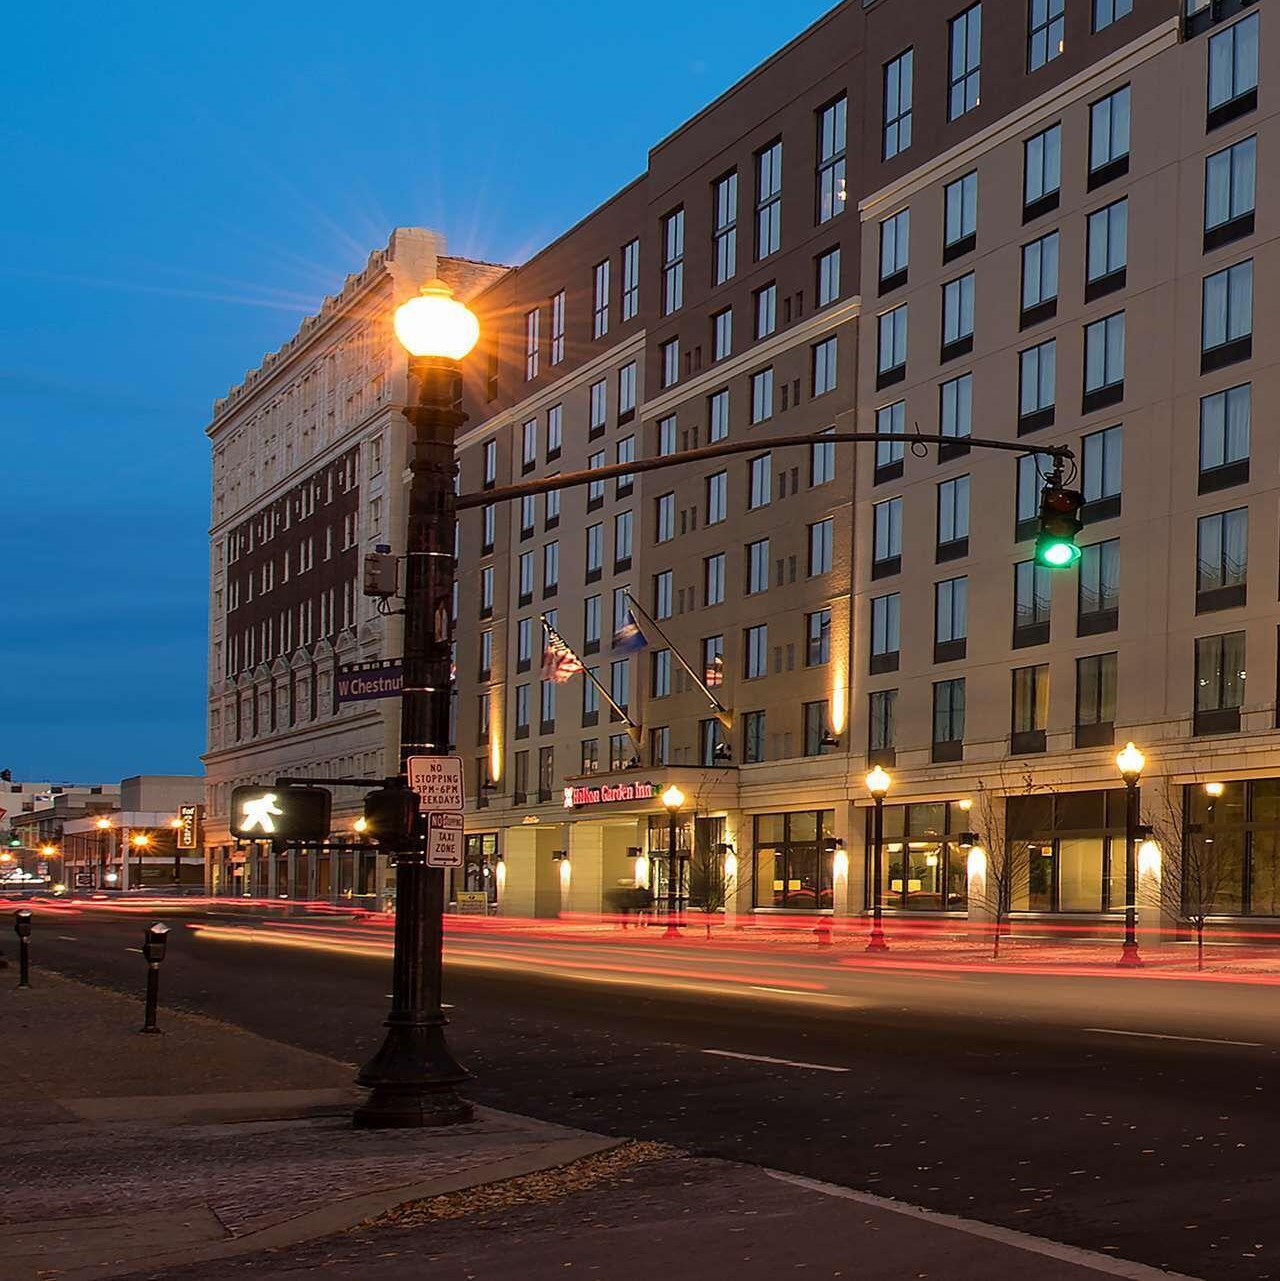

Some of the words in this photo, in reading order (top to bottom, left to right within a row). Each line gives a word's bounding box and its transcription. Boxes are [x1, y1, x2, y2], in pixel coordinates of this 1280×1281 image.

[338, 679, 350, 697] W
[430, 764, 442, 772] NO
[415, 774, 459, 784] STOPPING
[601, 783, 634, 802] Garden
[635, 781, 653, 799] Inn
[419, 795, 461, 805] EEKDAYS
[431, 814, 444, 828] NO
[439, 831, 455, 842] TAXI
[435, 843, 456, 854] ZONE
